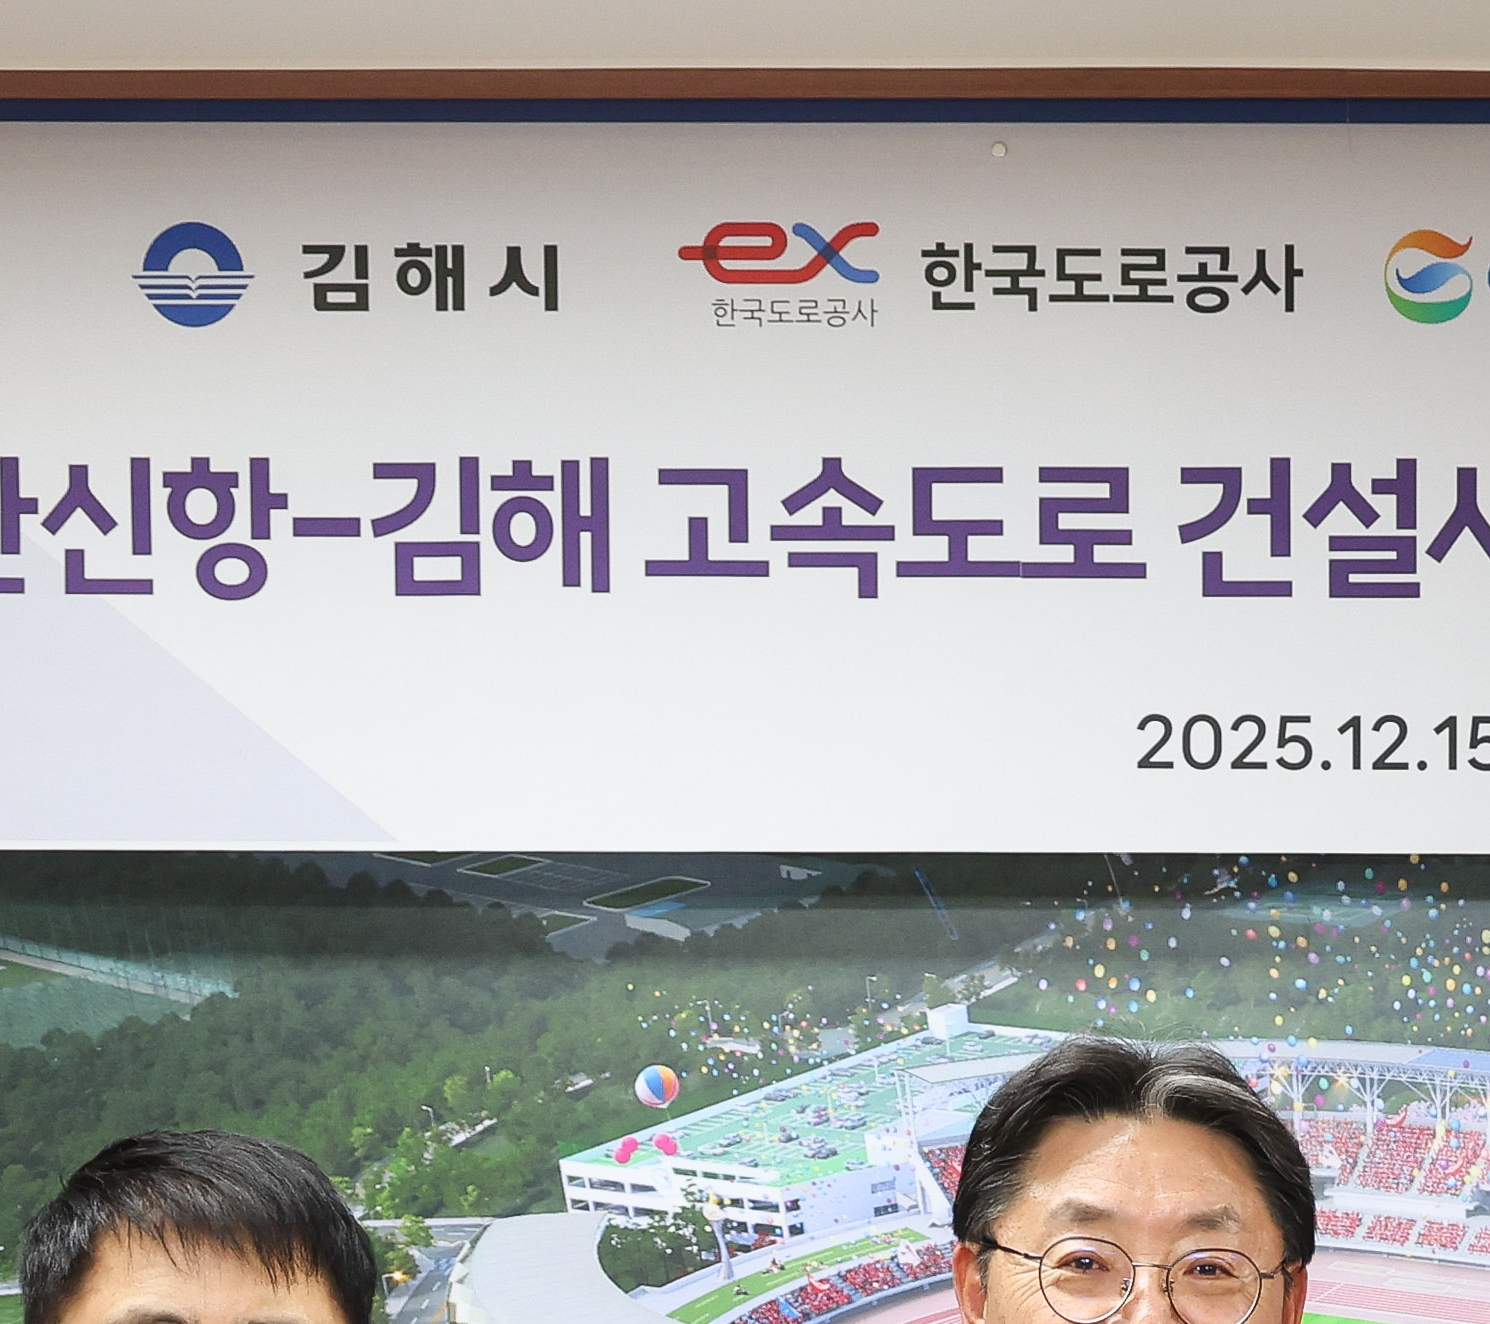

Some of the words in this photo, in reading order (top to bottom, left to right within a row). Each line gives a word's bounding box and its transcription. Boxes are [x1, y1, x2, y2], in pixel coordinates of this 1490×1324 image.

[679, 221, 879, 284] ex
[920, 240, 1305, 314] 한국도로공사
[710, 297, 880, 330] 한국도로공사
[643, 455, 1147, 600] 고속도로
